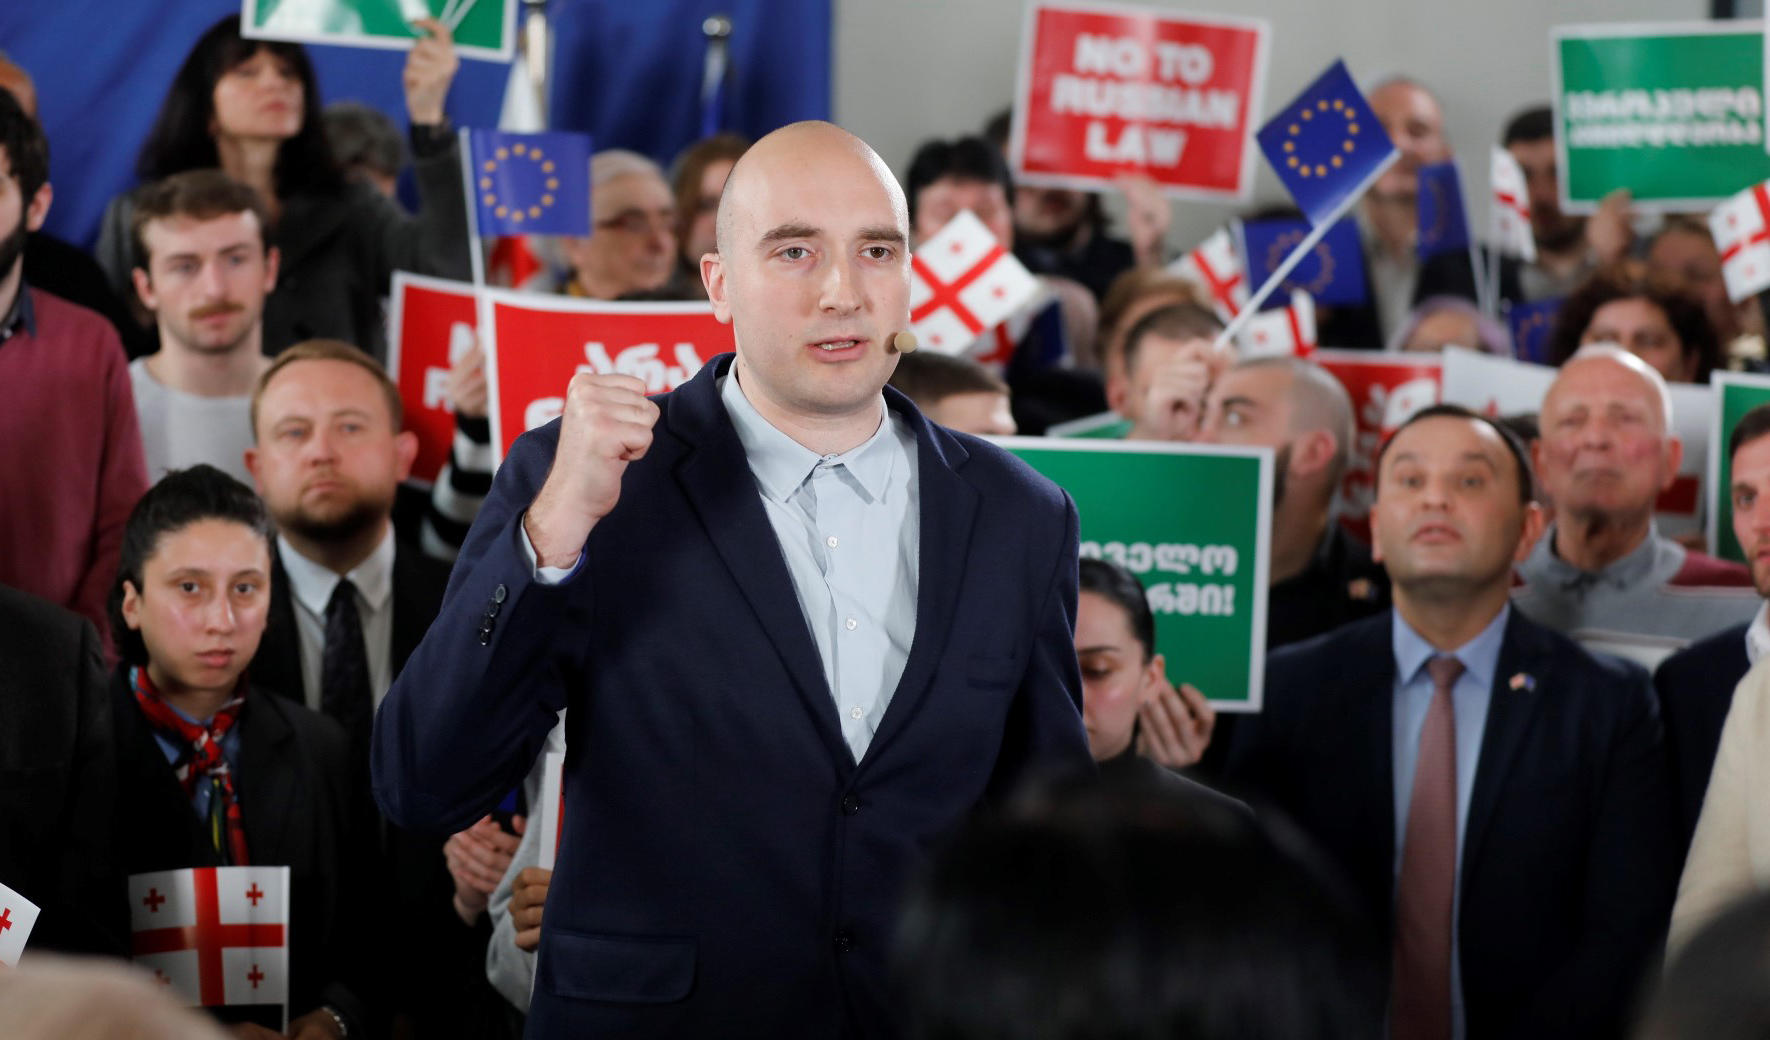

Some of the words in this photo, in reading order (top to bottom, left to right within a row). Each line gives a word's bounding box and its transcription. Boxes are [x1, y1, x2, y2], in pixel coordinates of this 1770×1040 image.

[1074, 33, 1143, 77] NO
[1158, 41, 1214, 85] TO
[1052, 74, 1237, 129] RUSSIAN
[1084, 121, 1187, 168] LAW
